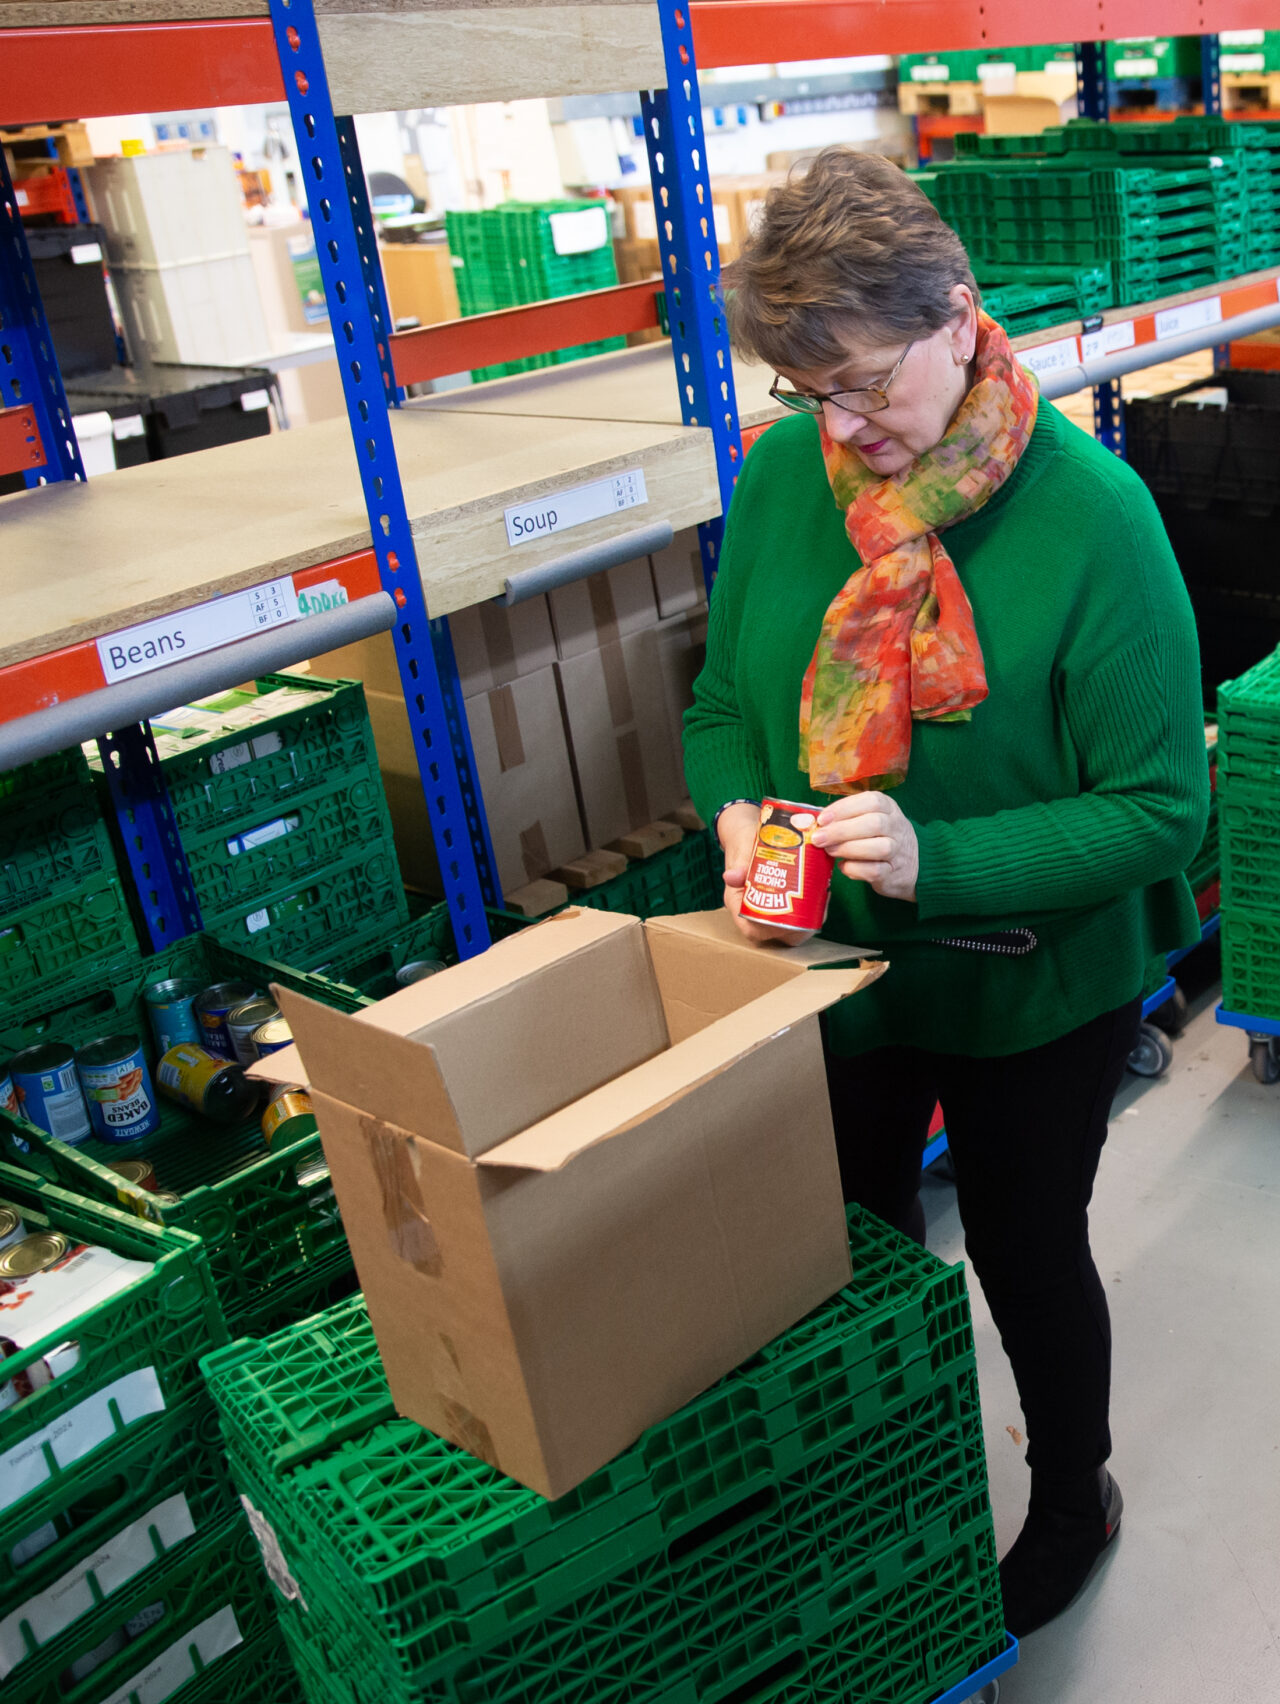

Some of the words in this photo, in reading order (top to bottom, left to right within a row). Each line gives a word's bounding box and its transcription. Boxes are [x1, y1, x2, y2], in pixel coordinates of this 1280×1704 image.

[1028, 353, 1057, 371] Sauce
[616, 489, 623, 497] AF
[512, 509, 558, 537] Soup
[255, 603, 265, 612] AF
[258, 615, 268, 624] BF
[109, 630, 186, 671] Beans
[757, 863, 788, 879] NOODLE
[754, 873, 787, 889] CHICKEN
[747, 886, 785, 908] HEINZ
[107, 1100, 149, 1123] BAKED
[112, 1098, 140, 1112] BEANS
[115, 1119, 151, 1137] NEWGATE
[52, 1420, 73, 1441] 2024
